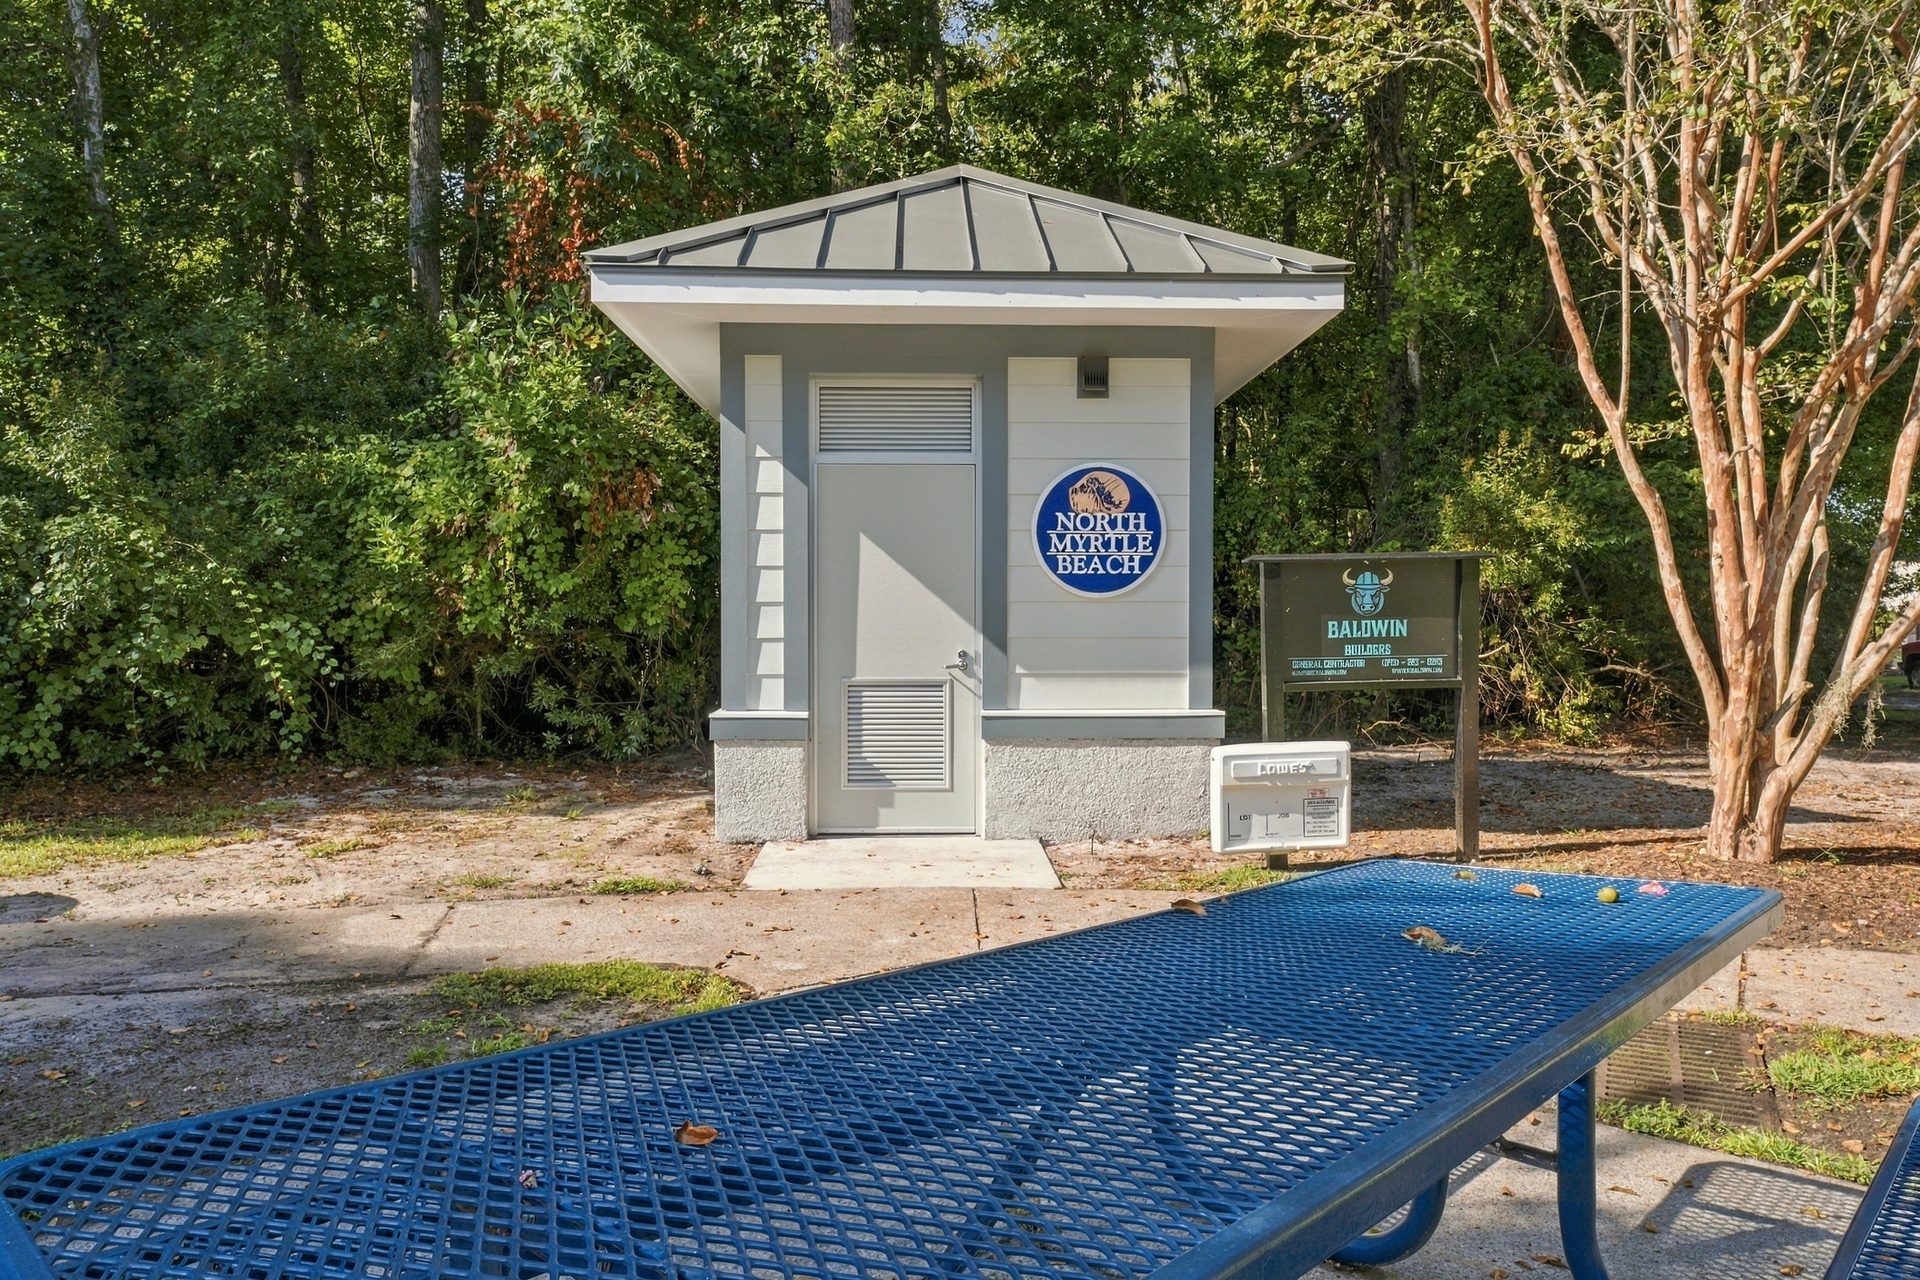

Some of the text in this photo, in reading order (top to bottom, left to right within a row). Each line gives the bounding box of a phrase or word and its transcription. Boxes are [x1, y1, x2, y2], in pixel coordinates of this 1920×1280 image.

[1055, 512, 1146, 531] NORTH
[1049, 533, 1153, 553] MYRTLE
[1056, 555, 1142, 575] BEACH
[1327, 619, 1409, 639] BALDWIN
[1344, 644, 1392, 656] BUILDERS
[1292, 659, 1366, 669] GENERAL CONTRACTOR
